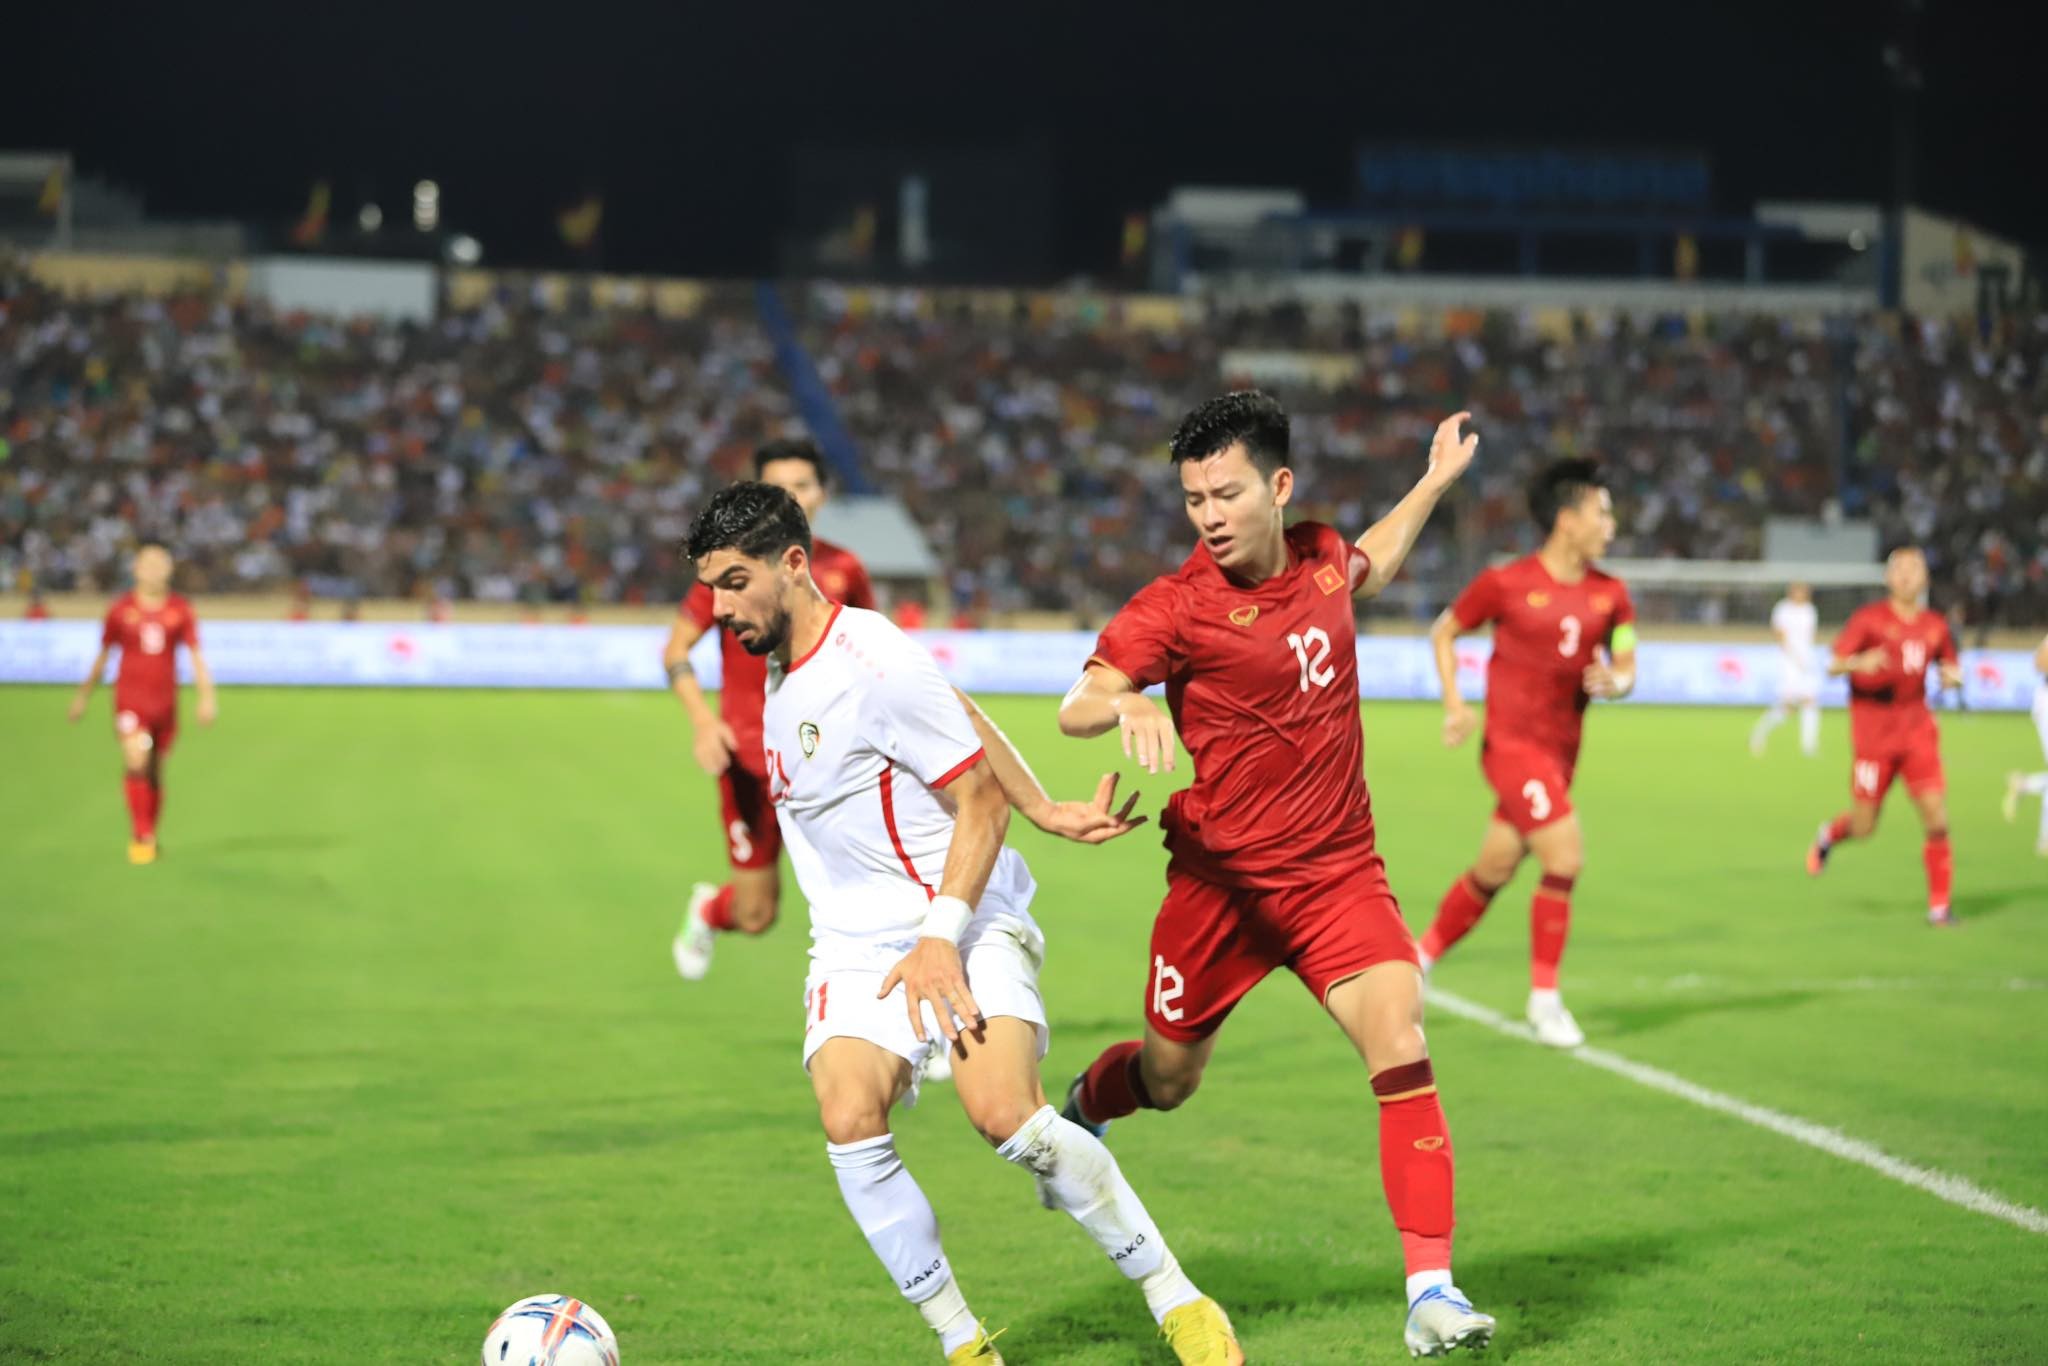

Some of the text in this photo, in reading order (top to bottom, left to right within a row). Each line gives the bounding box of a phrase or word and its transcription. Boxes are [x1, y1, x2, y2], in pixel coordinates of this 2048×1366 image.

[1558, 614, 1581, 658] 3
[1287, 626, 1336, 692] 12
[1522, 778, 1552, 820] 3
[1153, 954, 1185, 1022] 12
[903, 1259, 941, 1290] JAKO
